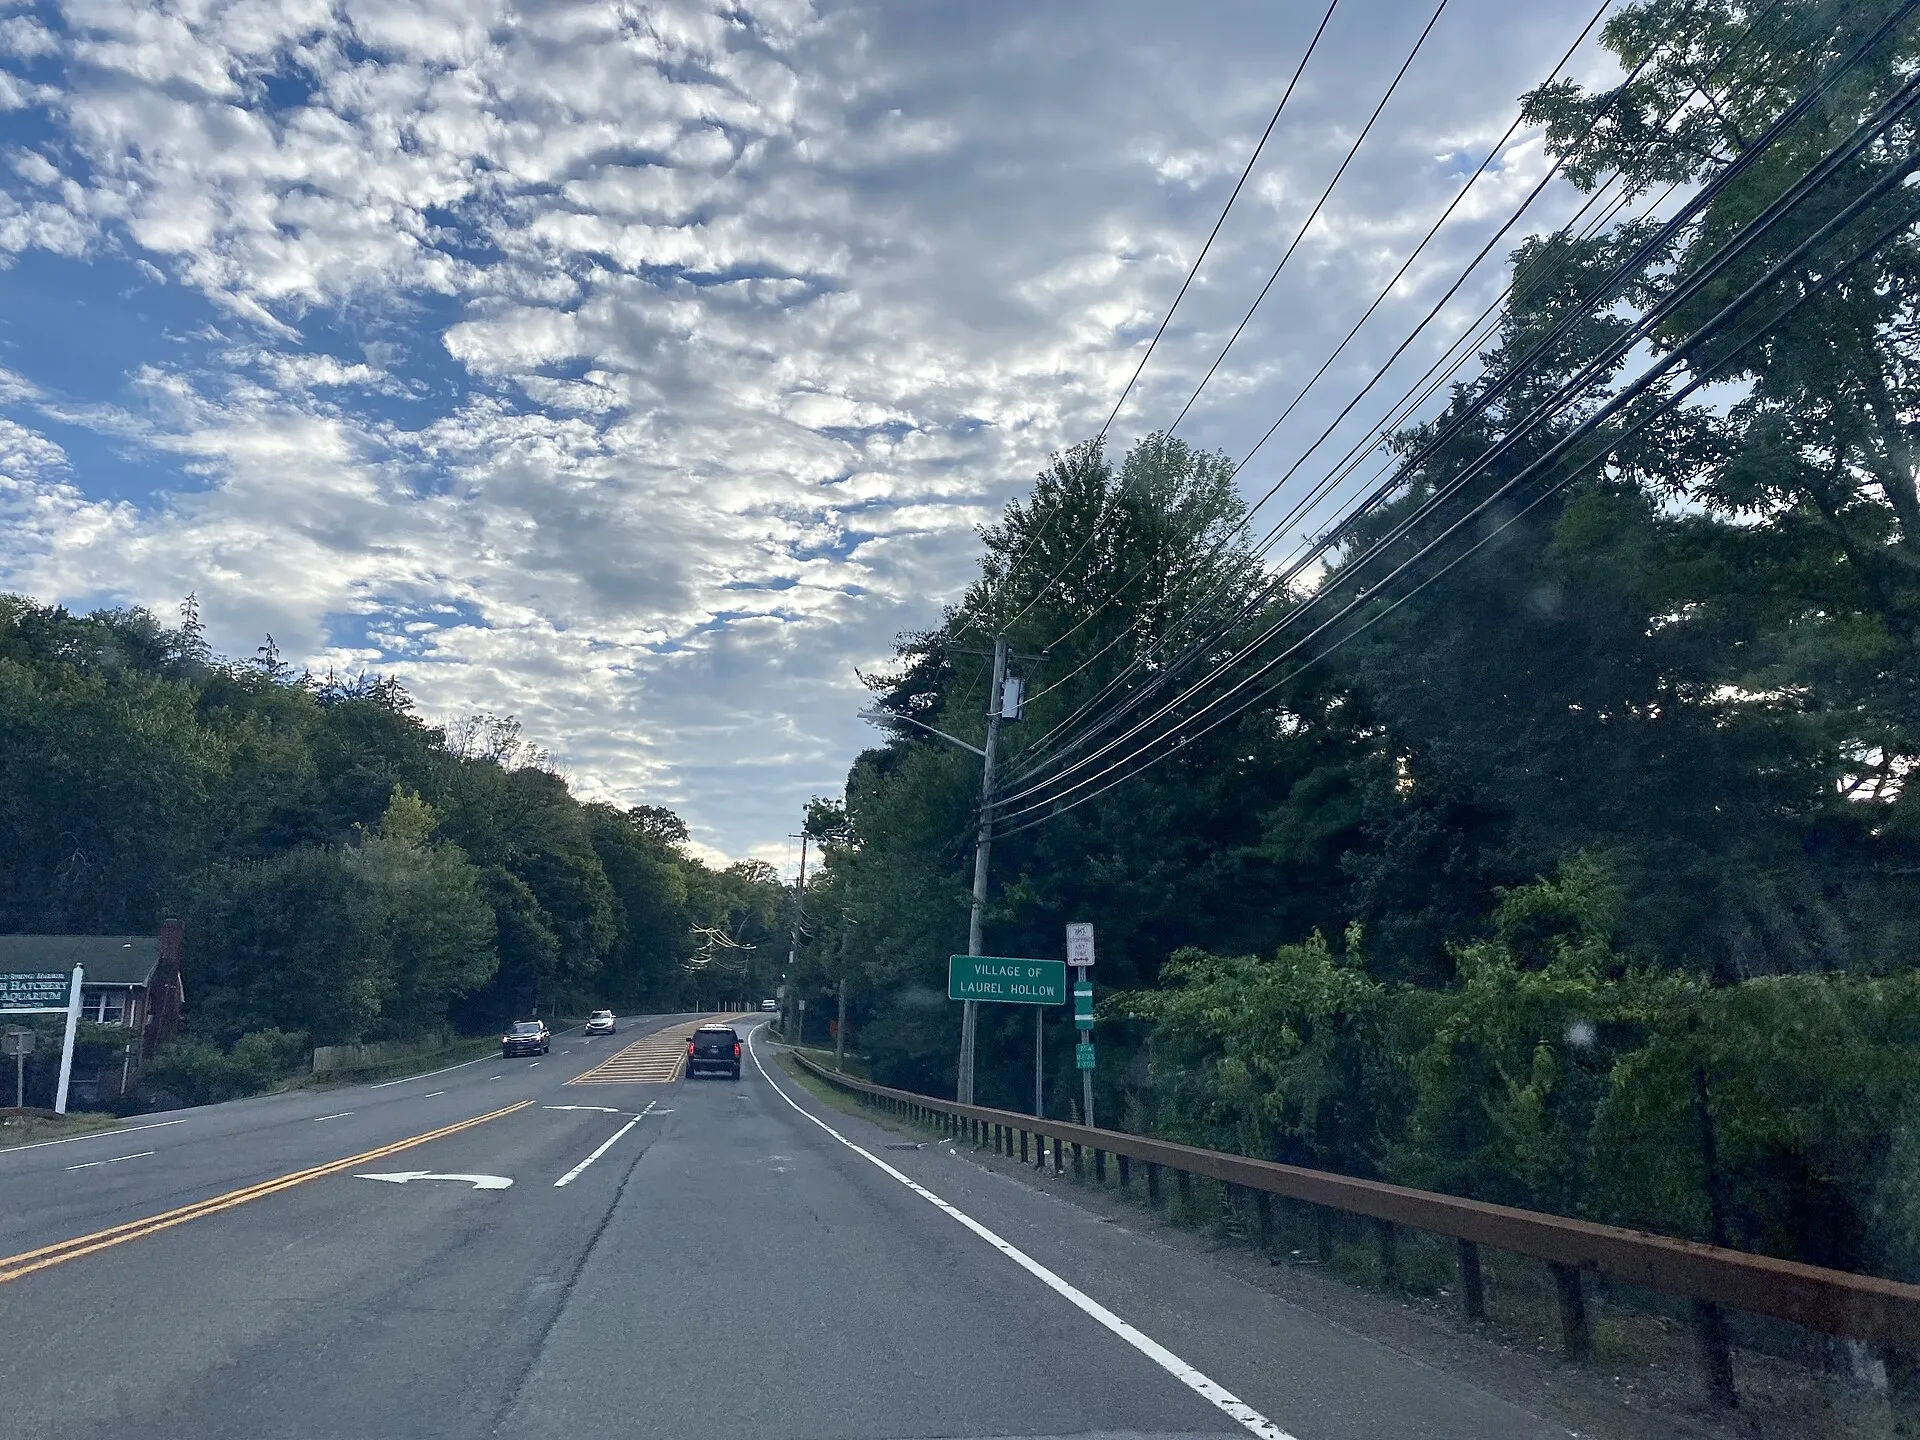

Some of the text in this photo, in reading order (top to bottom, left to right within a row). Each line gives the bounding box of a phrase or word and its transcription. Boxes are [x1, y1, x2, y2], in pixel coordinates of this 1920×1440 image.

[974, 964, 1042, 978] VILLAGE OF
[9, 981, 69, 990] HATCHERY
[960, 981, 1055, 996] LAUREL HOLLOW
[1, 992, 62, 1002] AQUARIUM
